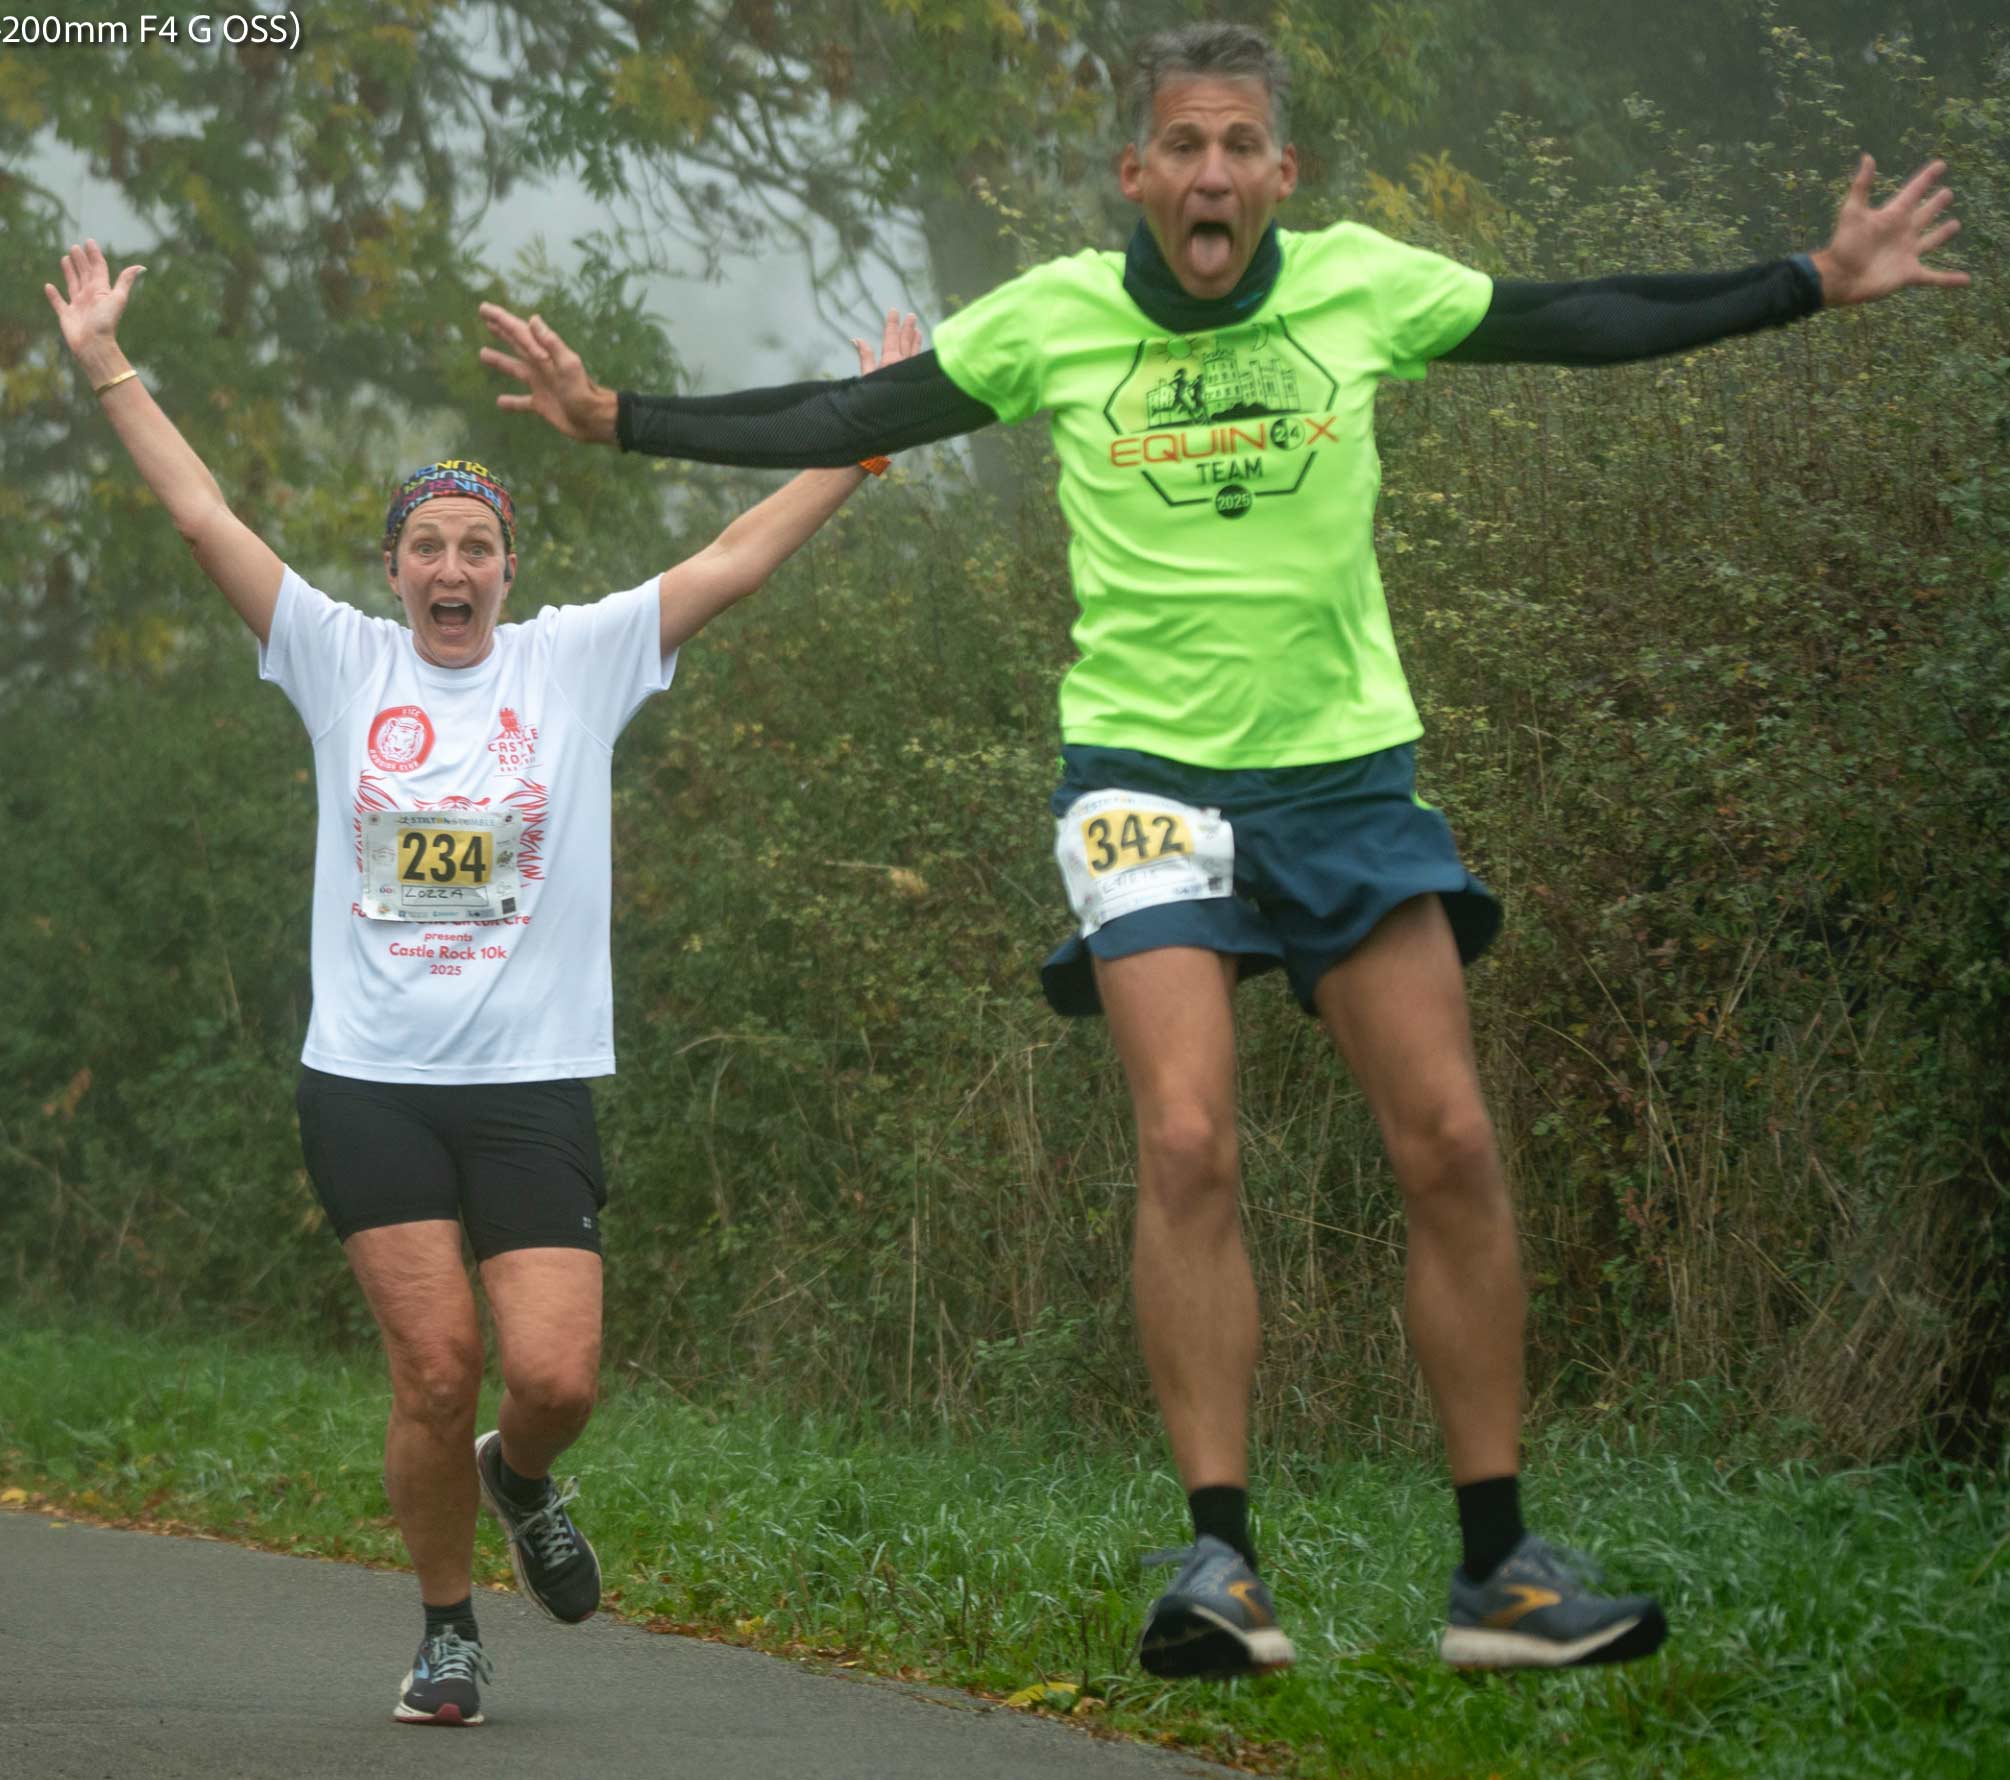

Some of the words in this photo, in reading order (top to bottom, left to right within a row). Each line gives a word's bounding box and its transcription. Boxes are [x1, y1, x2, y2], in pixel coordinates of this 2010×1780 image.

[1196, 457, 1264, 485] TEAM
[1217, 493, 1251, 511] 2025
[1088, 813, 1184, 872] 342
[402, 832, 487, 883] 234
[424, 932, 473, 942] presents
[388, 943, 434, 958] Castle
[439, 945, 475, 959] Rock
[481, 946, 508, 959] 10k
[430, 965, 462, 976] 2025
